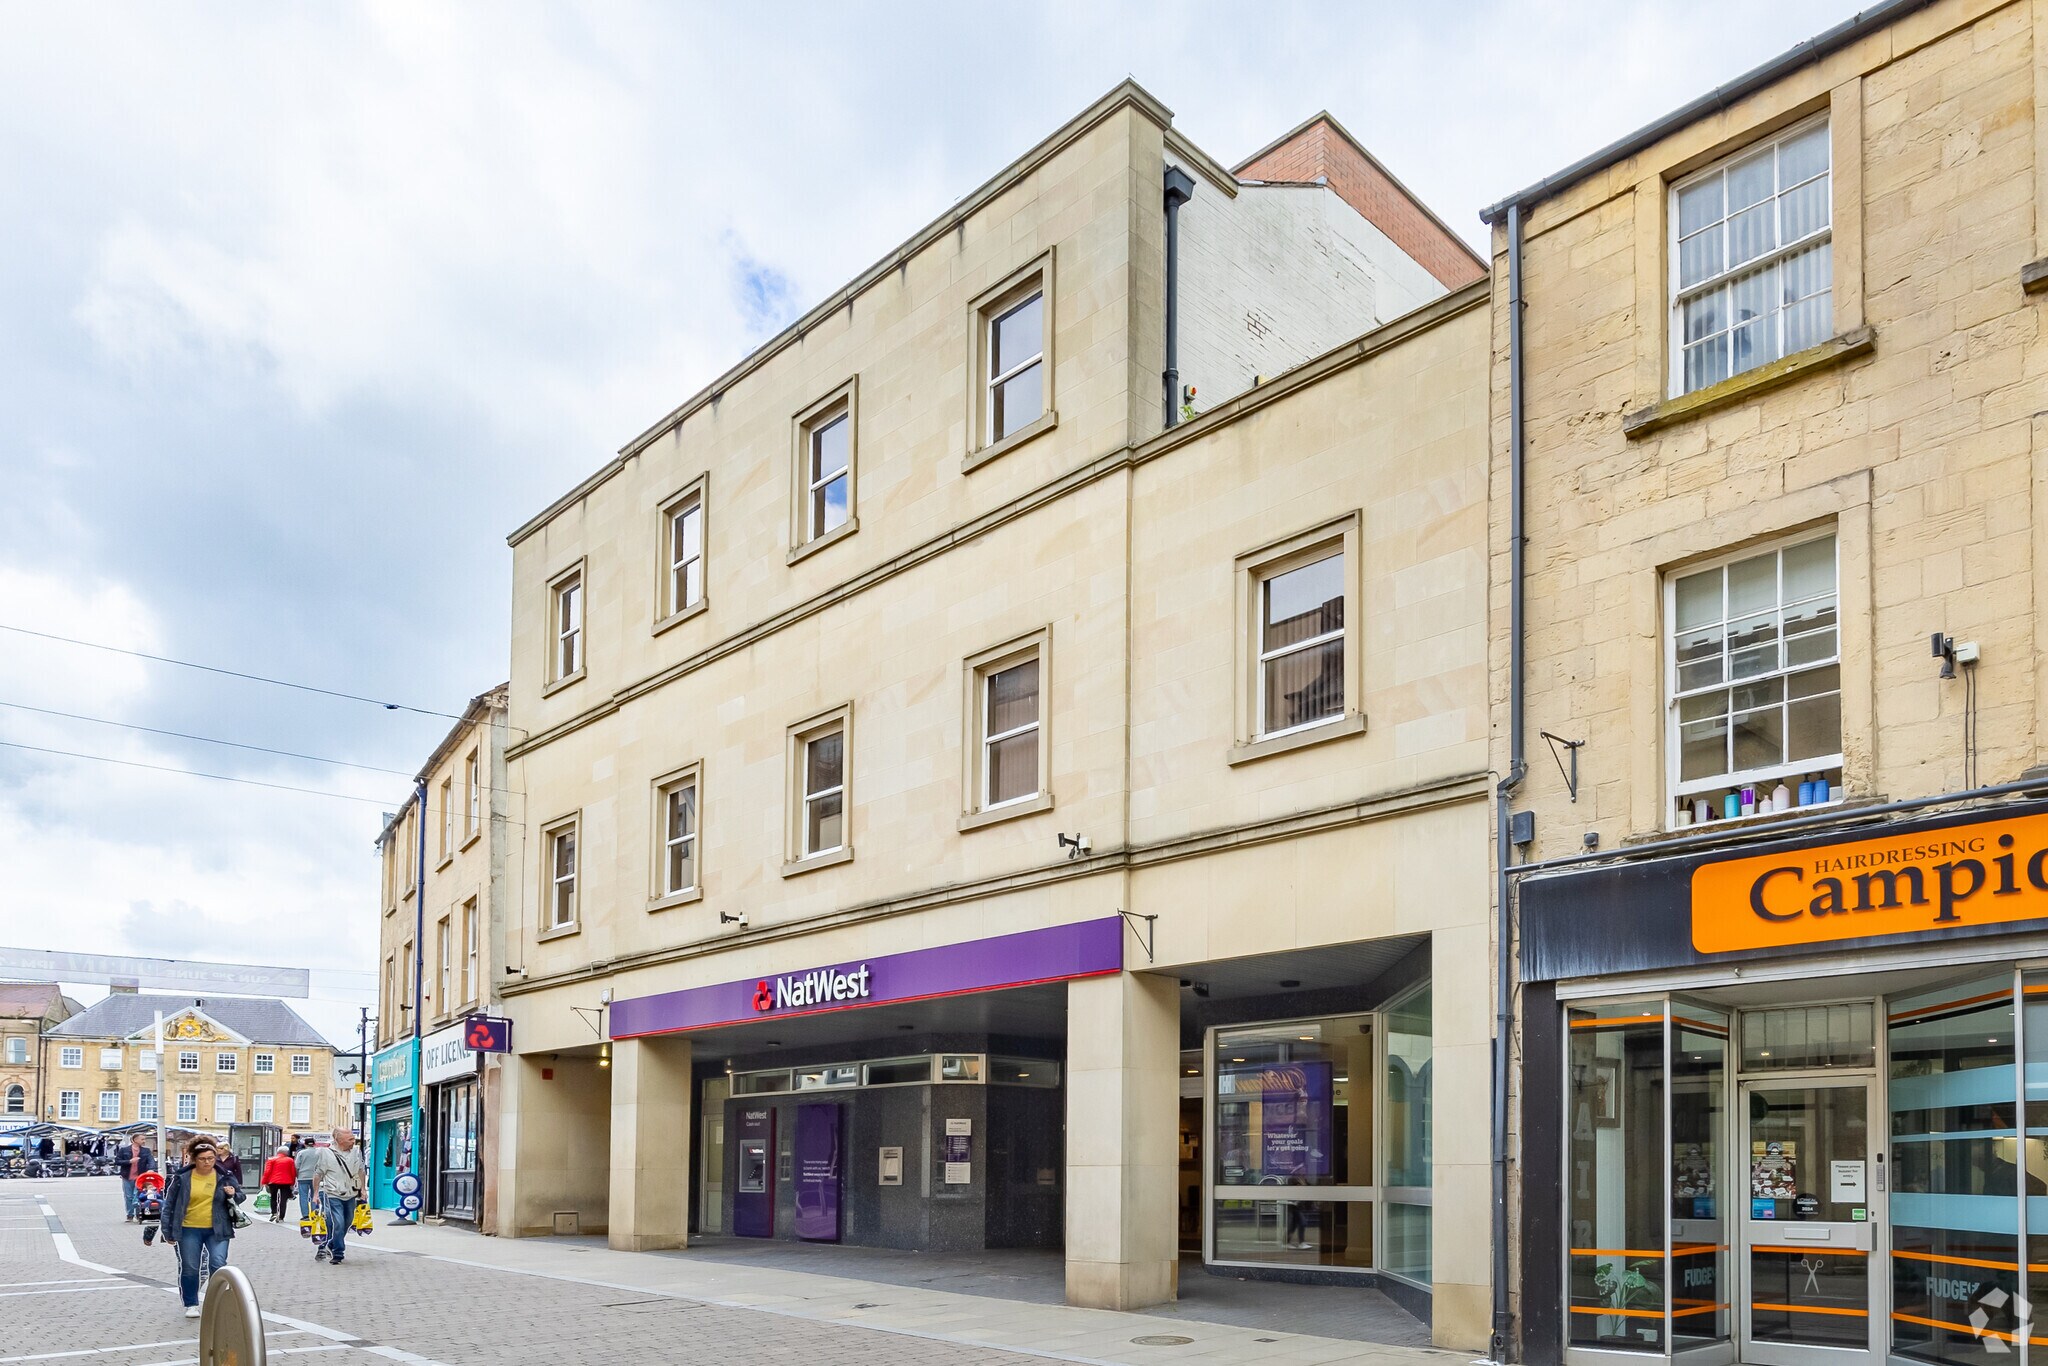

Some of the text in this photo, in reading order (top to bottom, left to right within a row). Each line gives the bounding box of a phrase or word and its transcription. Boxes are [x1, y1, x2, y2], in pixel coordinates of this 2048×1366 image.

[1814, 837, 1986, 874] HAIRDRESSING
[776, 963, 869, 1009] NatWest
[426, 1046, 439, 1070] OFF
[745, 1111, 767, 1120] NatWest
[1286, 1138, 1303, 1146] goals
[1685, 1266, 1713, 1287] FUDGE
[1926, 1276, 1969, 1301] FUDGE
